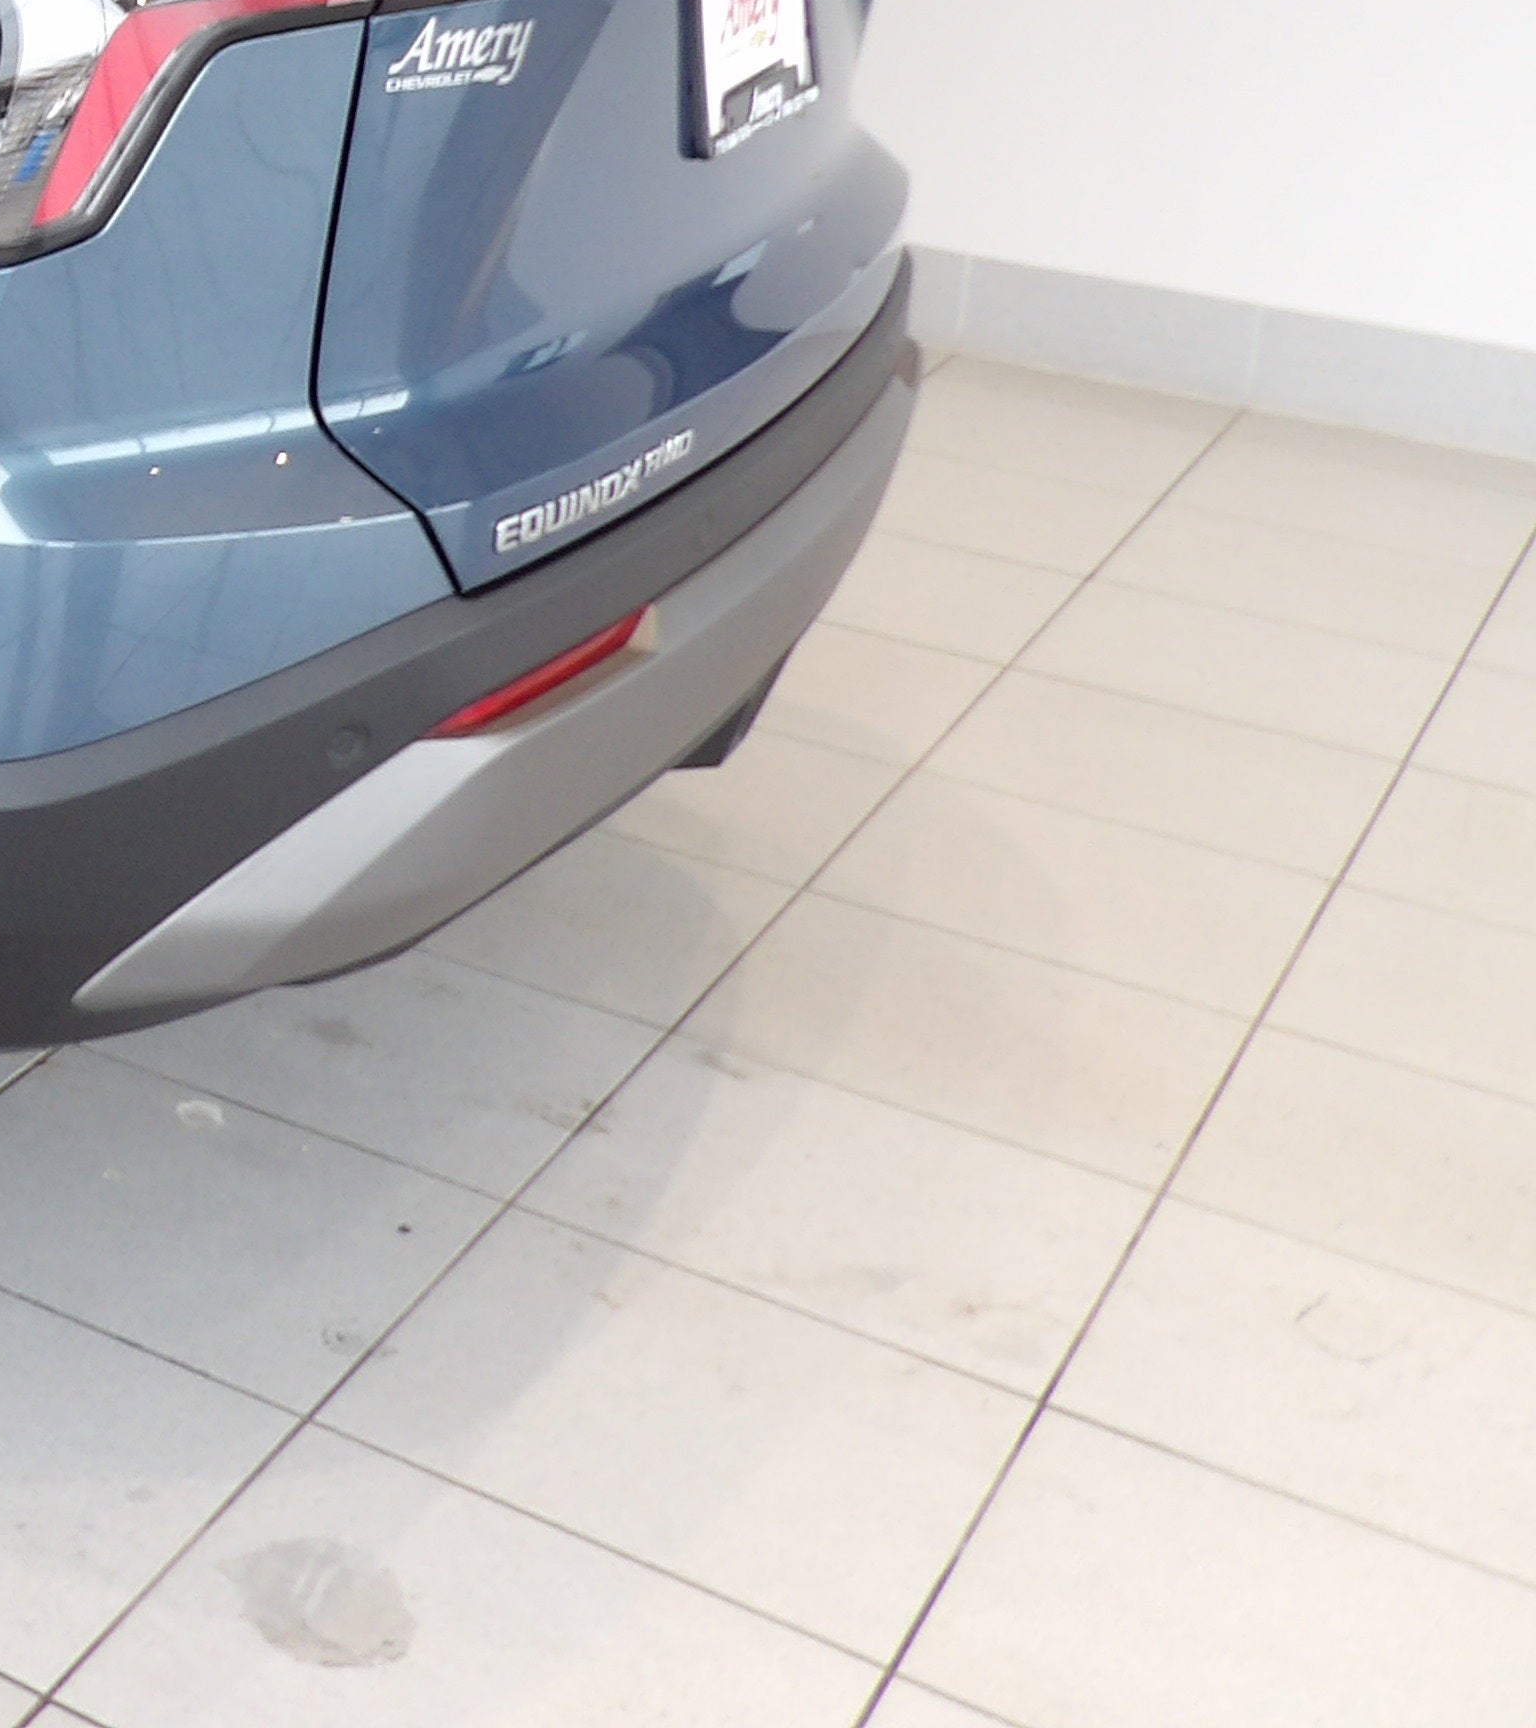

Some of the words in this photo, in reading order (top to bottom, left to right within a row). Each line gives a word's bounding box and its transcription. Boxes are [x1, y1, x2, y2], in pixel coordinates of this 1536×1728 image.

[385, 72, 472, 94] CHEVROLET
[387, 15, 535, 87] Amery
[494, 457, 644, 554] EQUINOX
[643, 428, 696, 478] AWD
